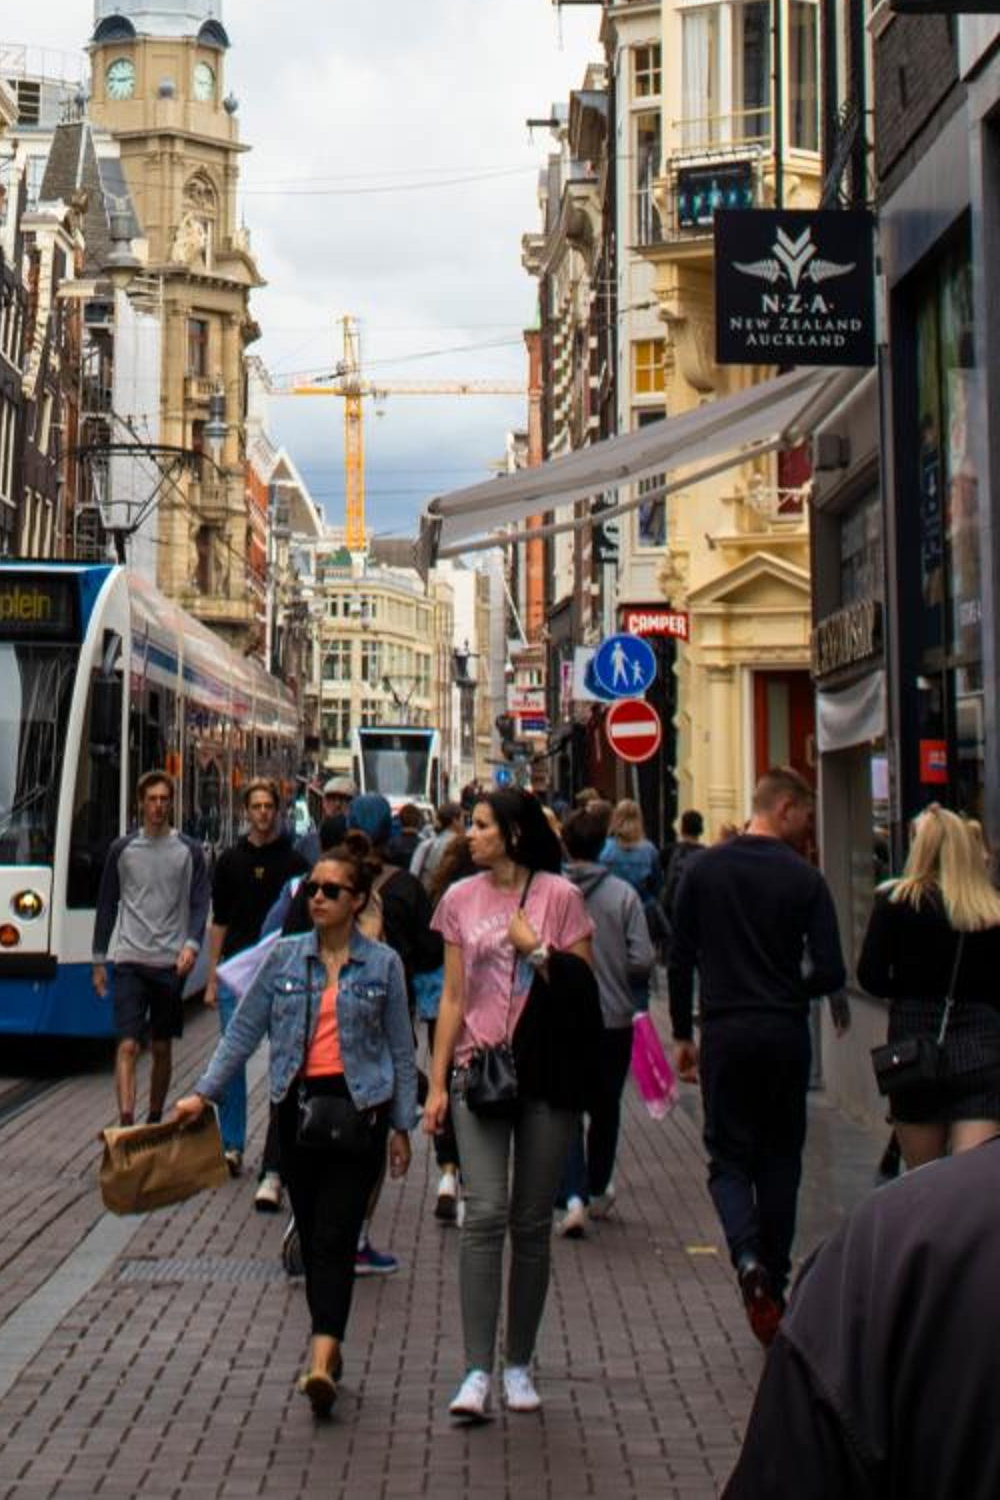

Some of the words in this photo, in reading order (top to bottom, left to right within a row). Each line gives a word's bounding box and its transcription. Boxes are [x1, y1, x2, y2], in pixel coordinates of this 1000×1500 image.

[729, 316, 770, 331] NEW
[779, 316, 863, 332] ZEALAND
[745, 333, 847, 347] AUCKLAND
[628, 612, 687, 638] CAMPER
